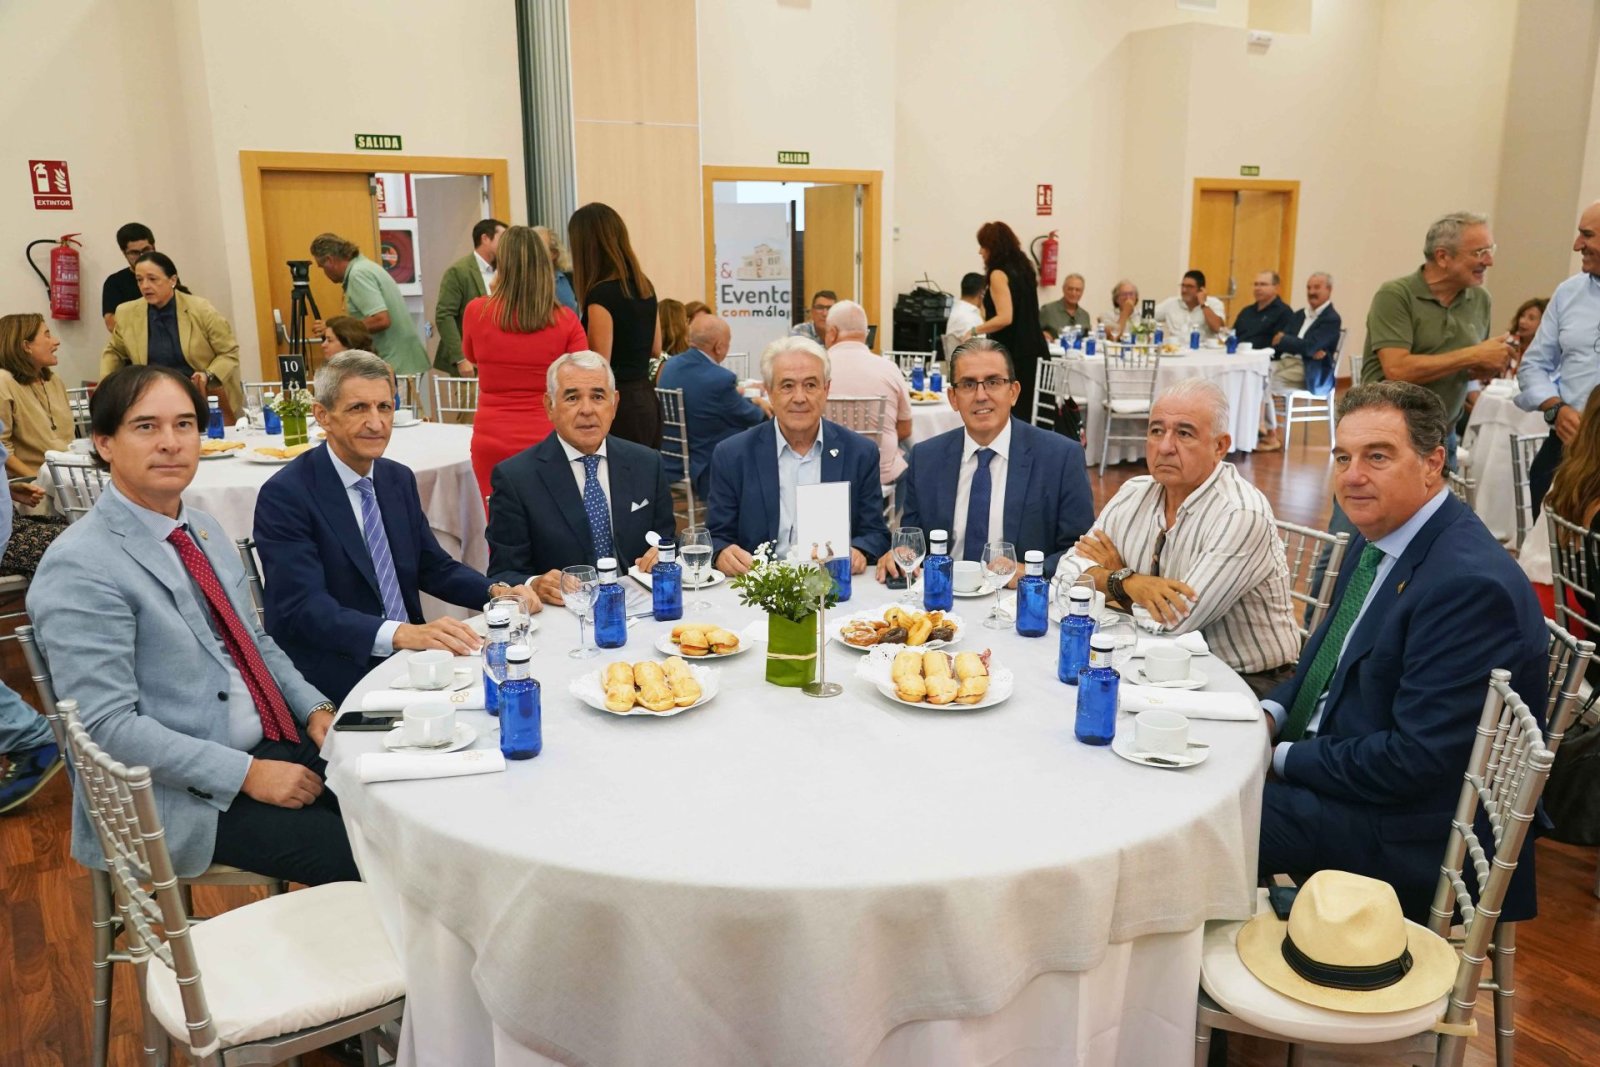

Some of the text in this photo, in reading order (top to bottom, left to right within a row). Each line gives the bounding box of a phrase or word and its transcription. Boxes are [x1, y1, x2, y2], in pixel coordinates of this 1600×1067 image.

[358, 136, 400, 149] SALIDA
[780, 152, 808, 163] SALIDA
[284, 360, 299, 373] 10
